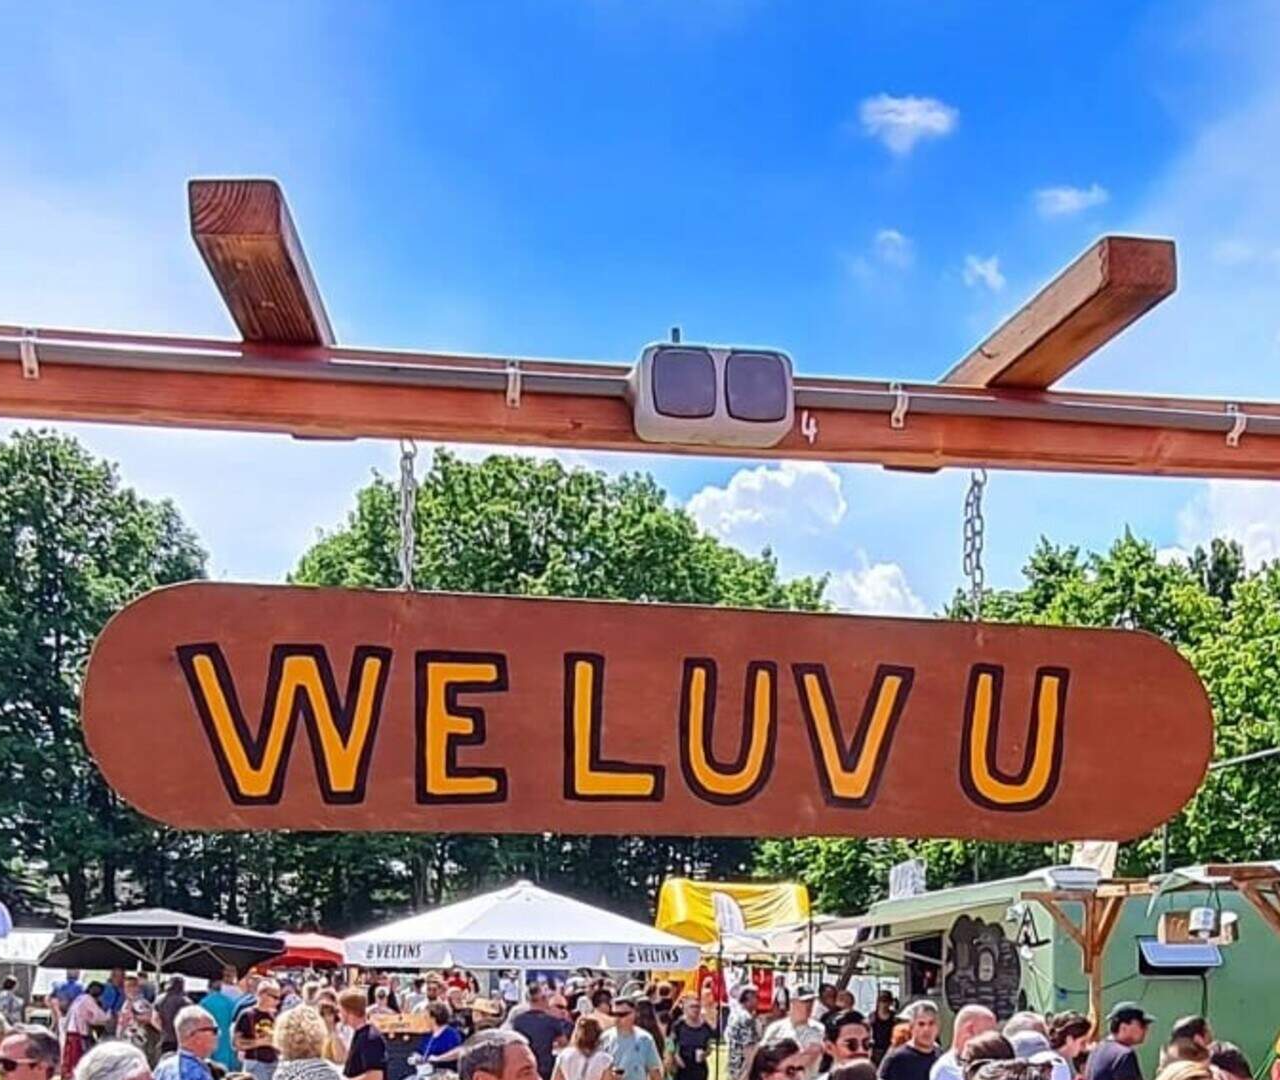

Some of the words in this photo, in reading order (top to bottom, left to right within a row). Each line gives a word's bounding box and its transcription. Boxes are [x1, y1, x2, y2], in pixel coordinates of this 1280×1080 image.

[801, 410, 818, 444] 4
[175, 643, 510, 805] WE
[563, 652, 916, 809] LUV
[959, 663, 1071, 813] U
[376, 943, 422, 959] VELTINS
[502, 944, 569, 960] VELTINS
[637, 948, 680, 963] VELTINS
